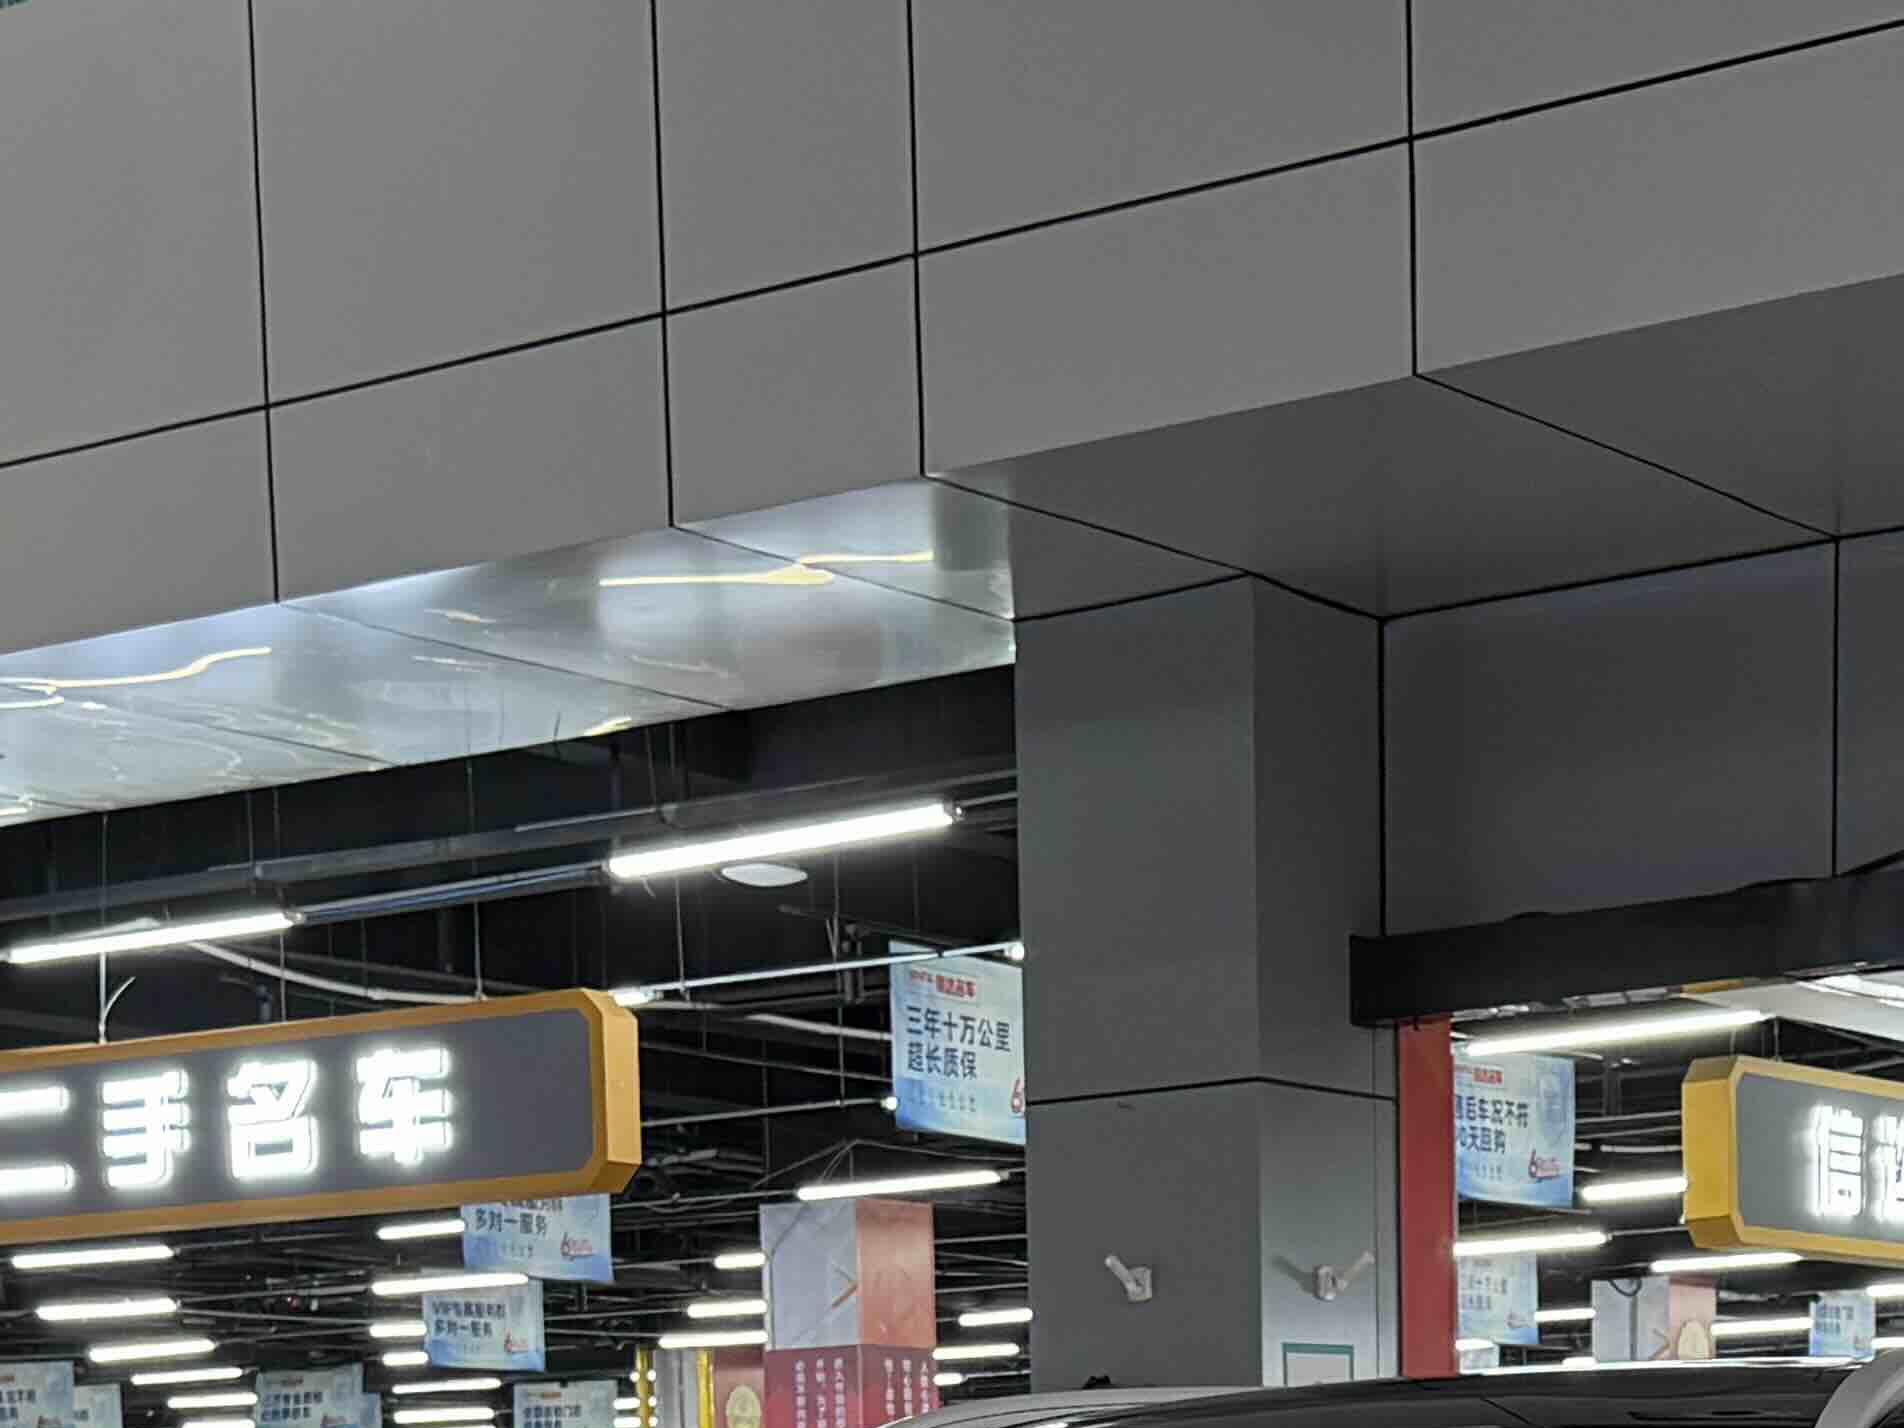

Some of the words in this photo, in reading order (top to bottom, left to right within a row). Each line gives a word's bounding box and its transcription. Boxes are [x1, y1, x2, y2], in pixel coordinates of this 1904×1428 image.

[906, 1005, 1011, 1053] 三年十万公里
